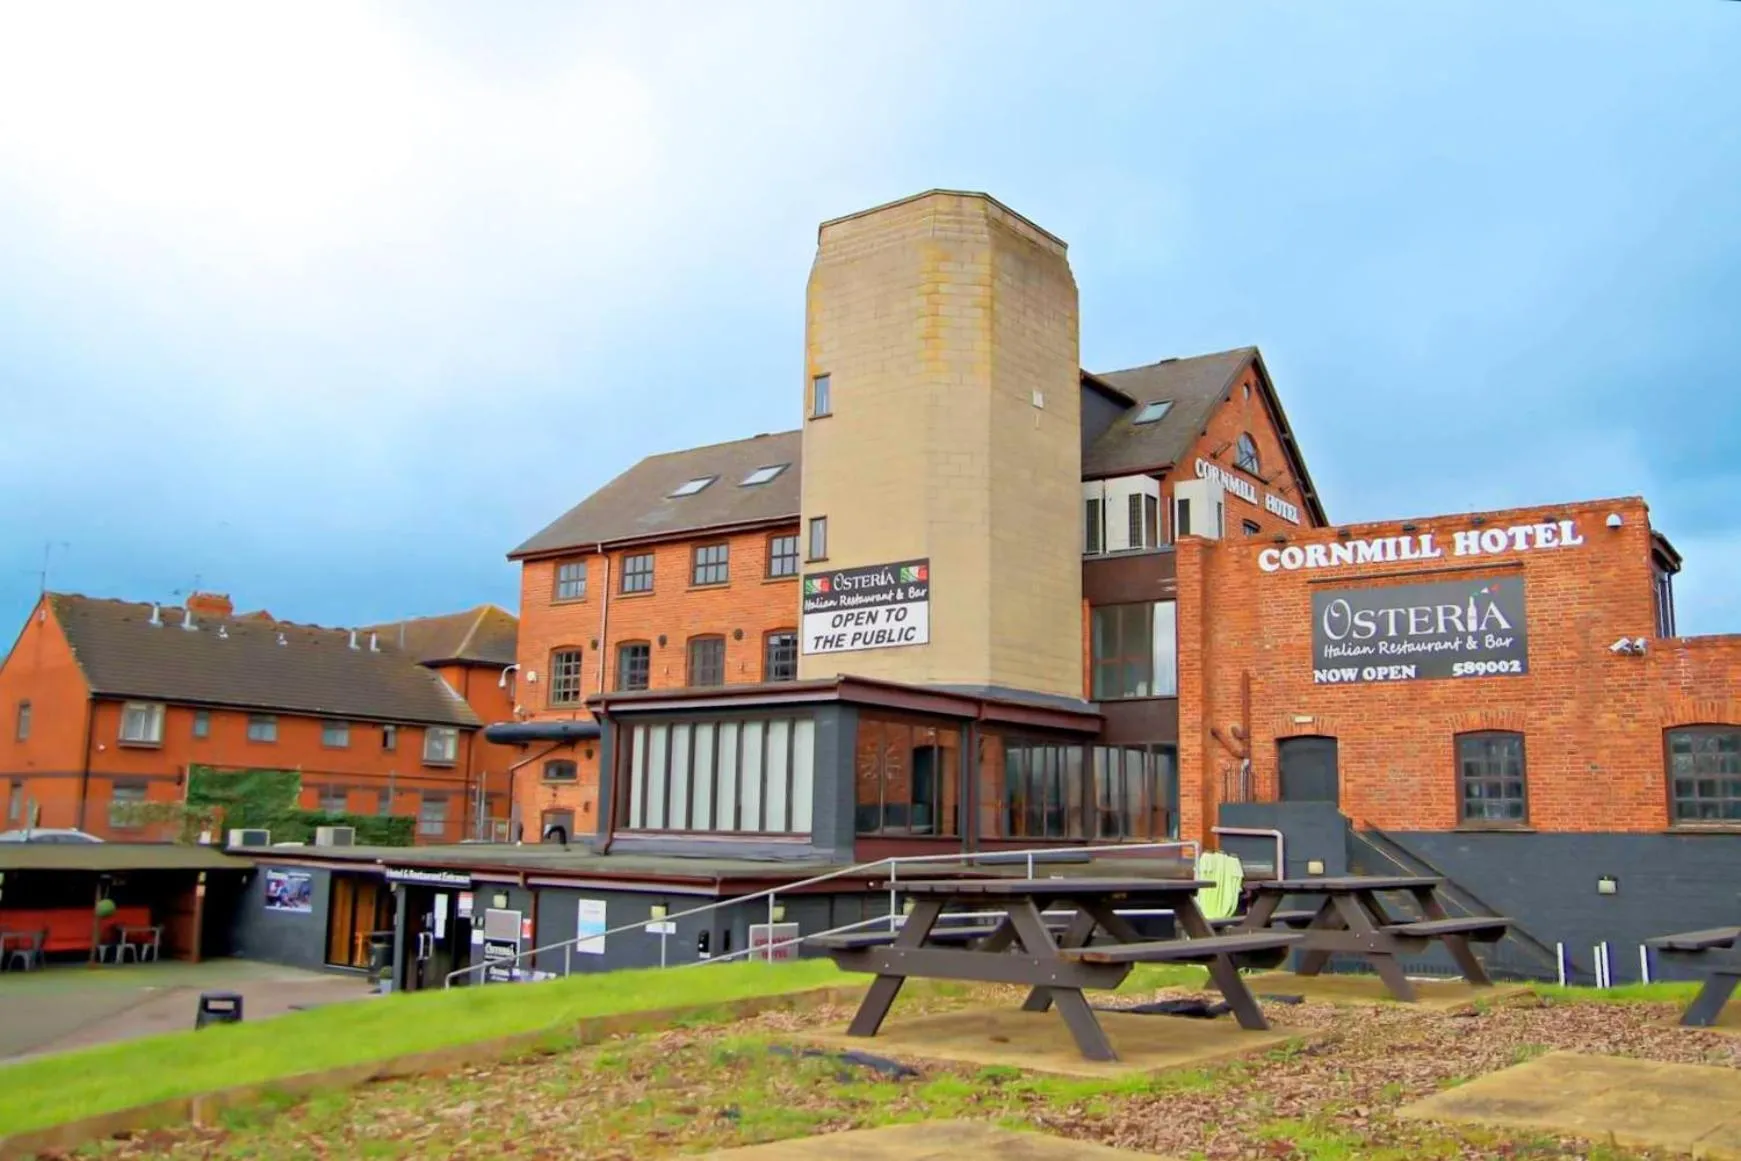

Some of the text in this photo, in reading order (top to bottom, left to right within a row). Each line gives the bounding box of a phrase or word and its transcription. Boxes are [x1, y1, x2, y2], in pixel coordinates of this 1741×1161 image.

[1195, 457, 1300, 526] CORNMILL HOTEL
[1258, 520, 1584, 572] CORNMILL HOTEL
[804, 586, 927, 612] Italian Restaurant & Bar
[831, 606, 908, 629] OPEN TO
[814, 626, 917, 650] THE PUBLIC
[1323, 634, 1514, 659] Italian Restaurant & Bar
[1313, 660, 1522, 684] NOW OPEN 589002
